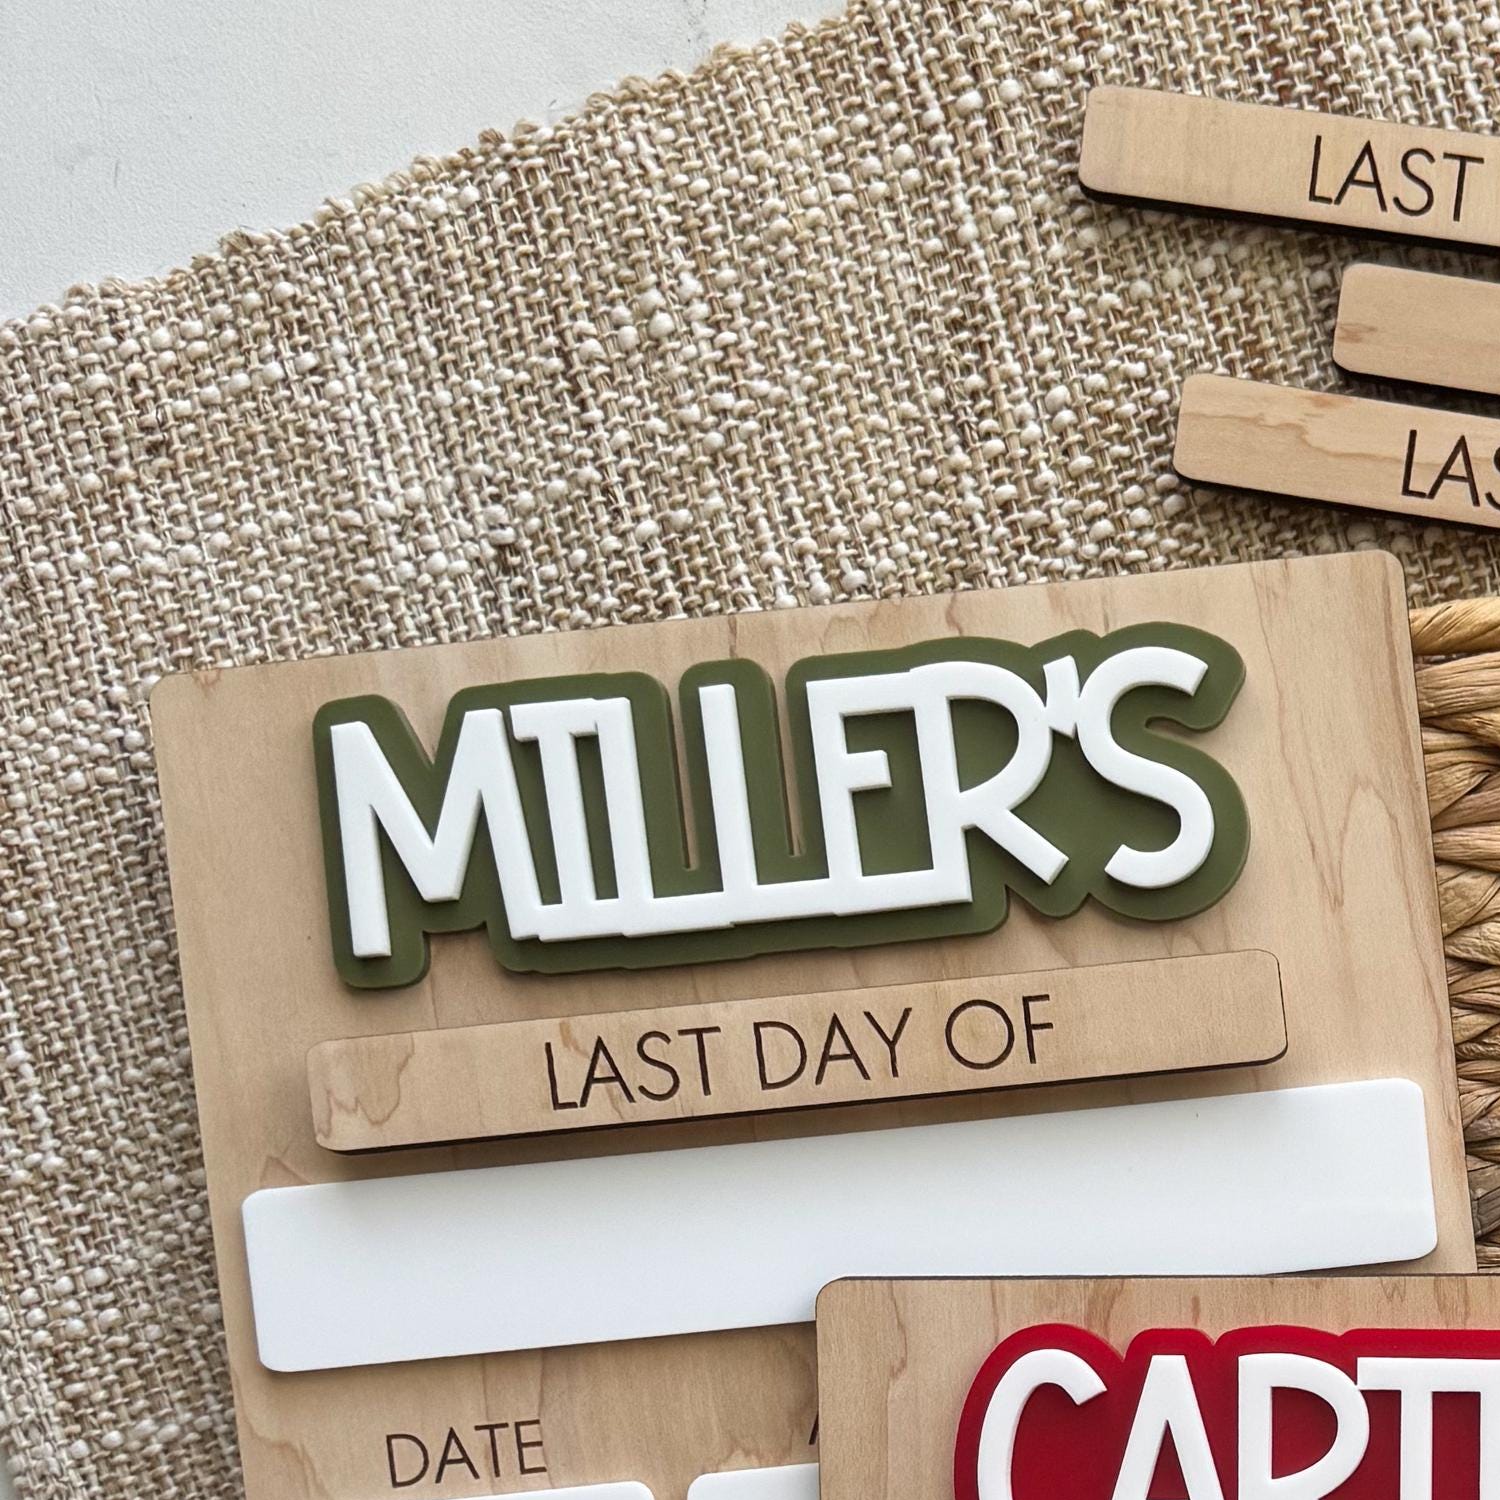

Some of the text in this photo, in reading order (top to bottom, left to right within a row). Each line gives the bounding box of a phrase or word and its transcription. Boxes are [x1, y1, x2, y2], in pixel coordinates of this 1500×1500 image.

[1307, 134, 1485, 222] LAST
[329, 645, 1215, 958] MILLER'S
[544, 993, 1054, 1114] LAST DAY OF
[385, 1418, 548, 1489] DATE
